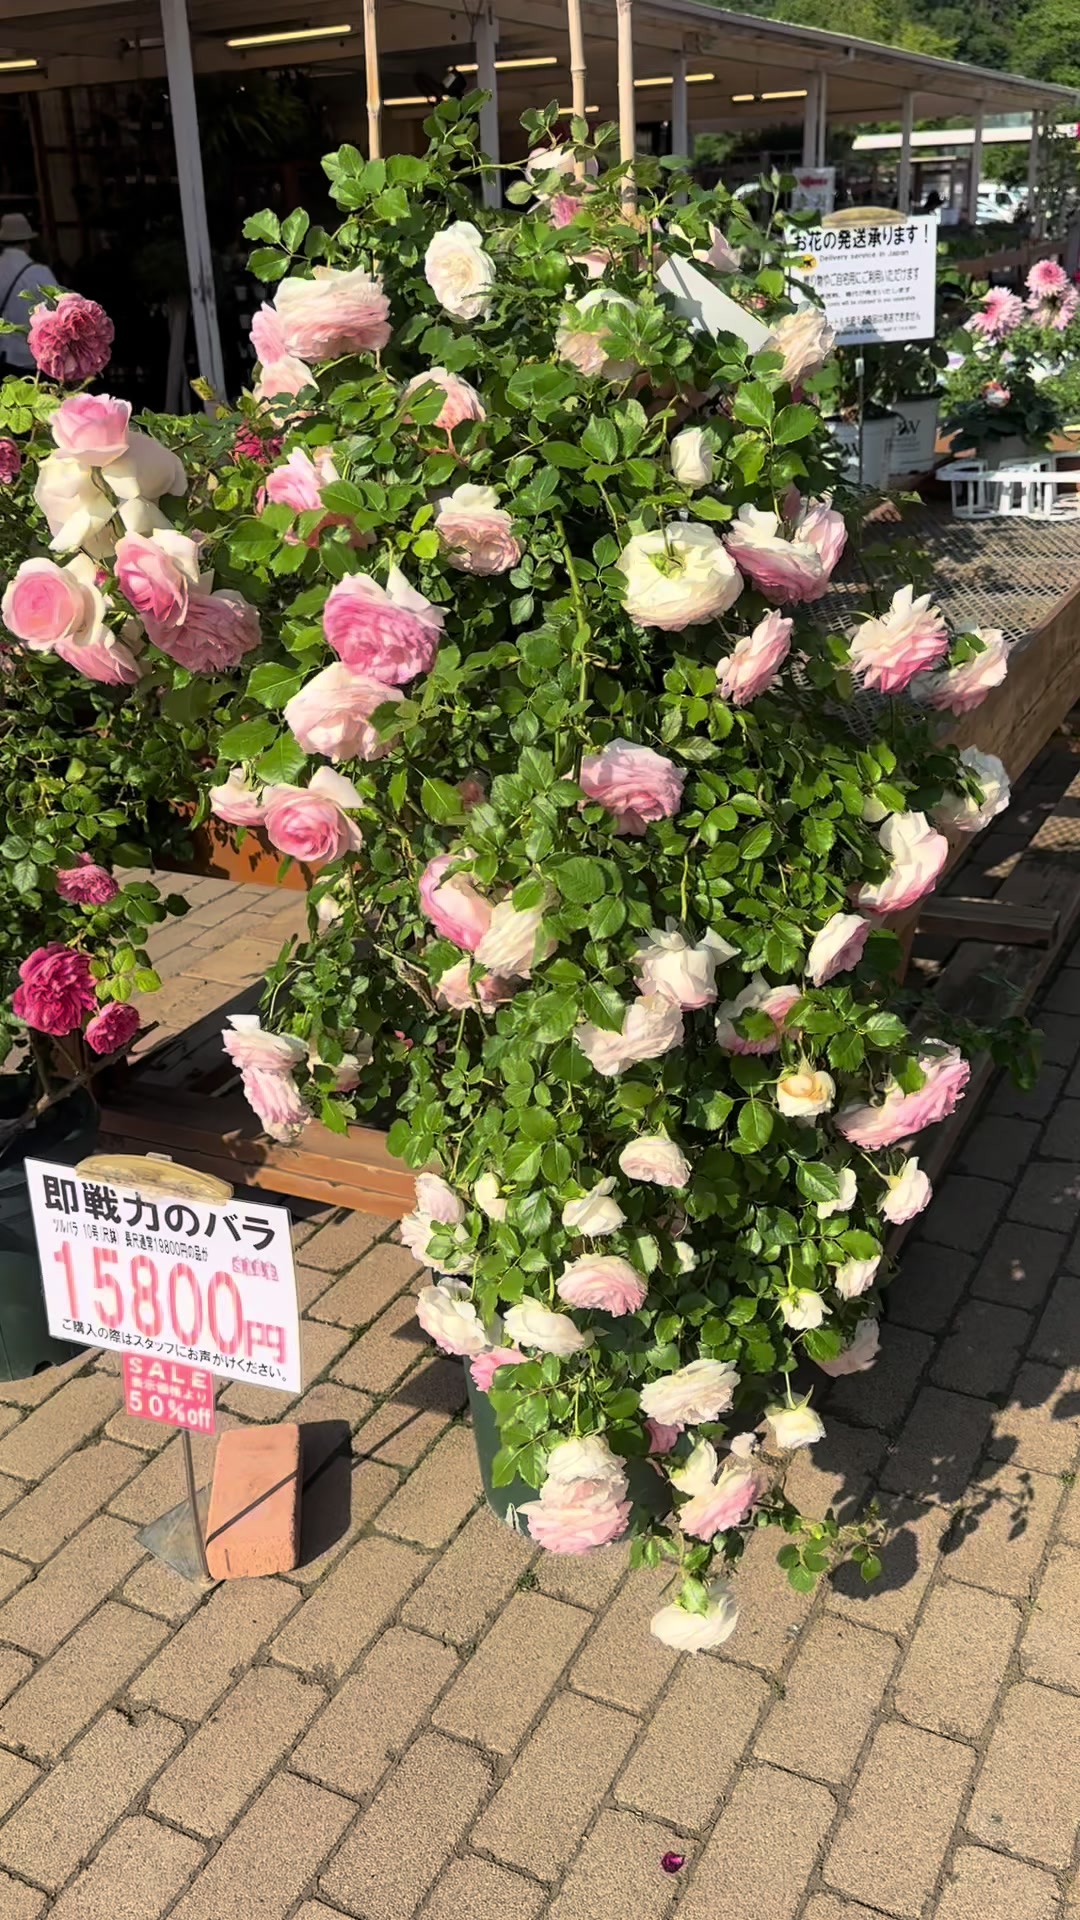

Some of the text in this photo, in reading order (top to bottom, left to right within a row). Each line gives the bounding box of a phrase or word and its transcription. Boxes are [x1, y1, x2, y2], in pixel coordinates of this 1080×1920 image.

[820, 254, 848, 262] Delivery
[850, 252, 876, 260] service
[888, 249, 909, 258] Japan
[43, 1175, 275, 1251] 即戦力のバラ
[55, 1241, 286, 1364] 15800円
[129, 1357, 207, 1389] SALE
